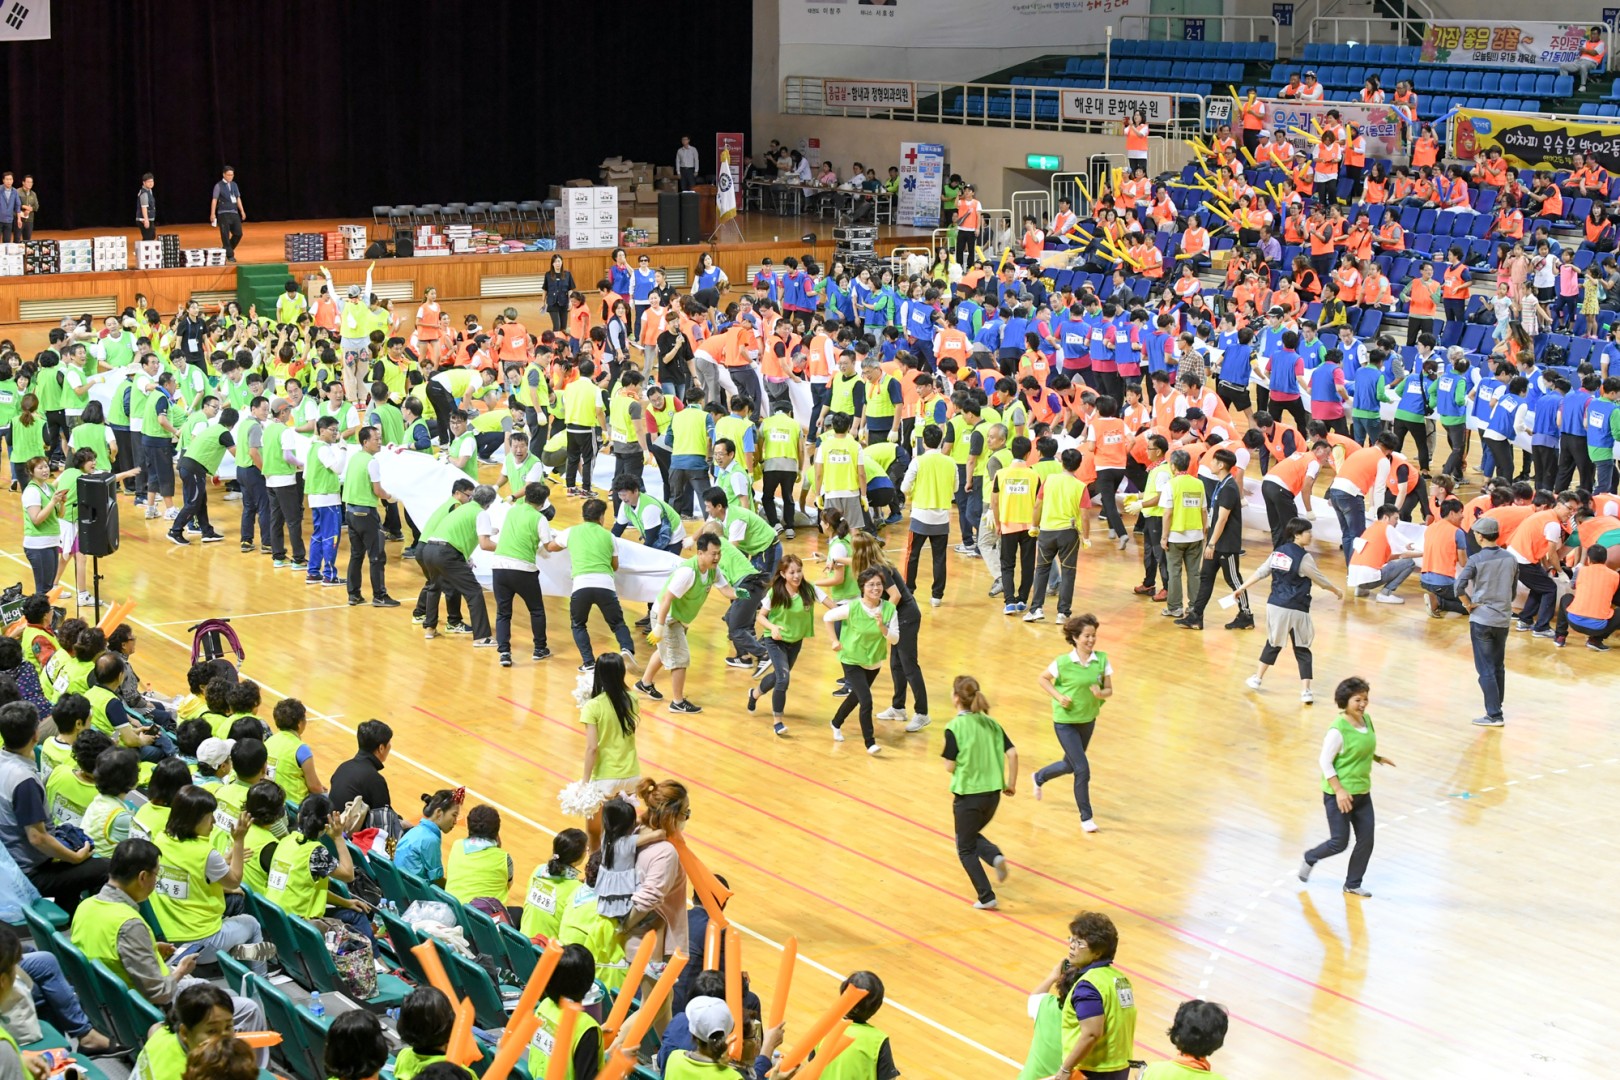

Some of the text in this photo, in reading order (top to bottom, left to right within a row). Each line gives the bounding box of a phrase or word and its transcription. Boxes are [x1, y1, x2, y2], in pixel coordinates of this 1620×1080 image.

[1186, 27, 1201, 41] 2-1
[1434, 26, 1461, 49] 가장
[1462, 26, 1490, 49] 좋은
[1500, 52, 1516, 63] 우1동
[871, 87, 909, 103] 정형외과의원
[1074, 97, 1159, 118] 해운대 문화예술원
[1209, 105, 1228, 117] 우1동
[1505, 131, 1538, 147] 어차피
[1542, 134, 1576, 155] 우승은
